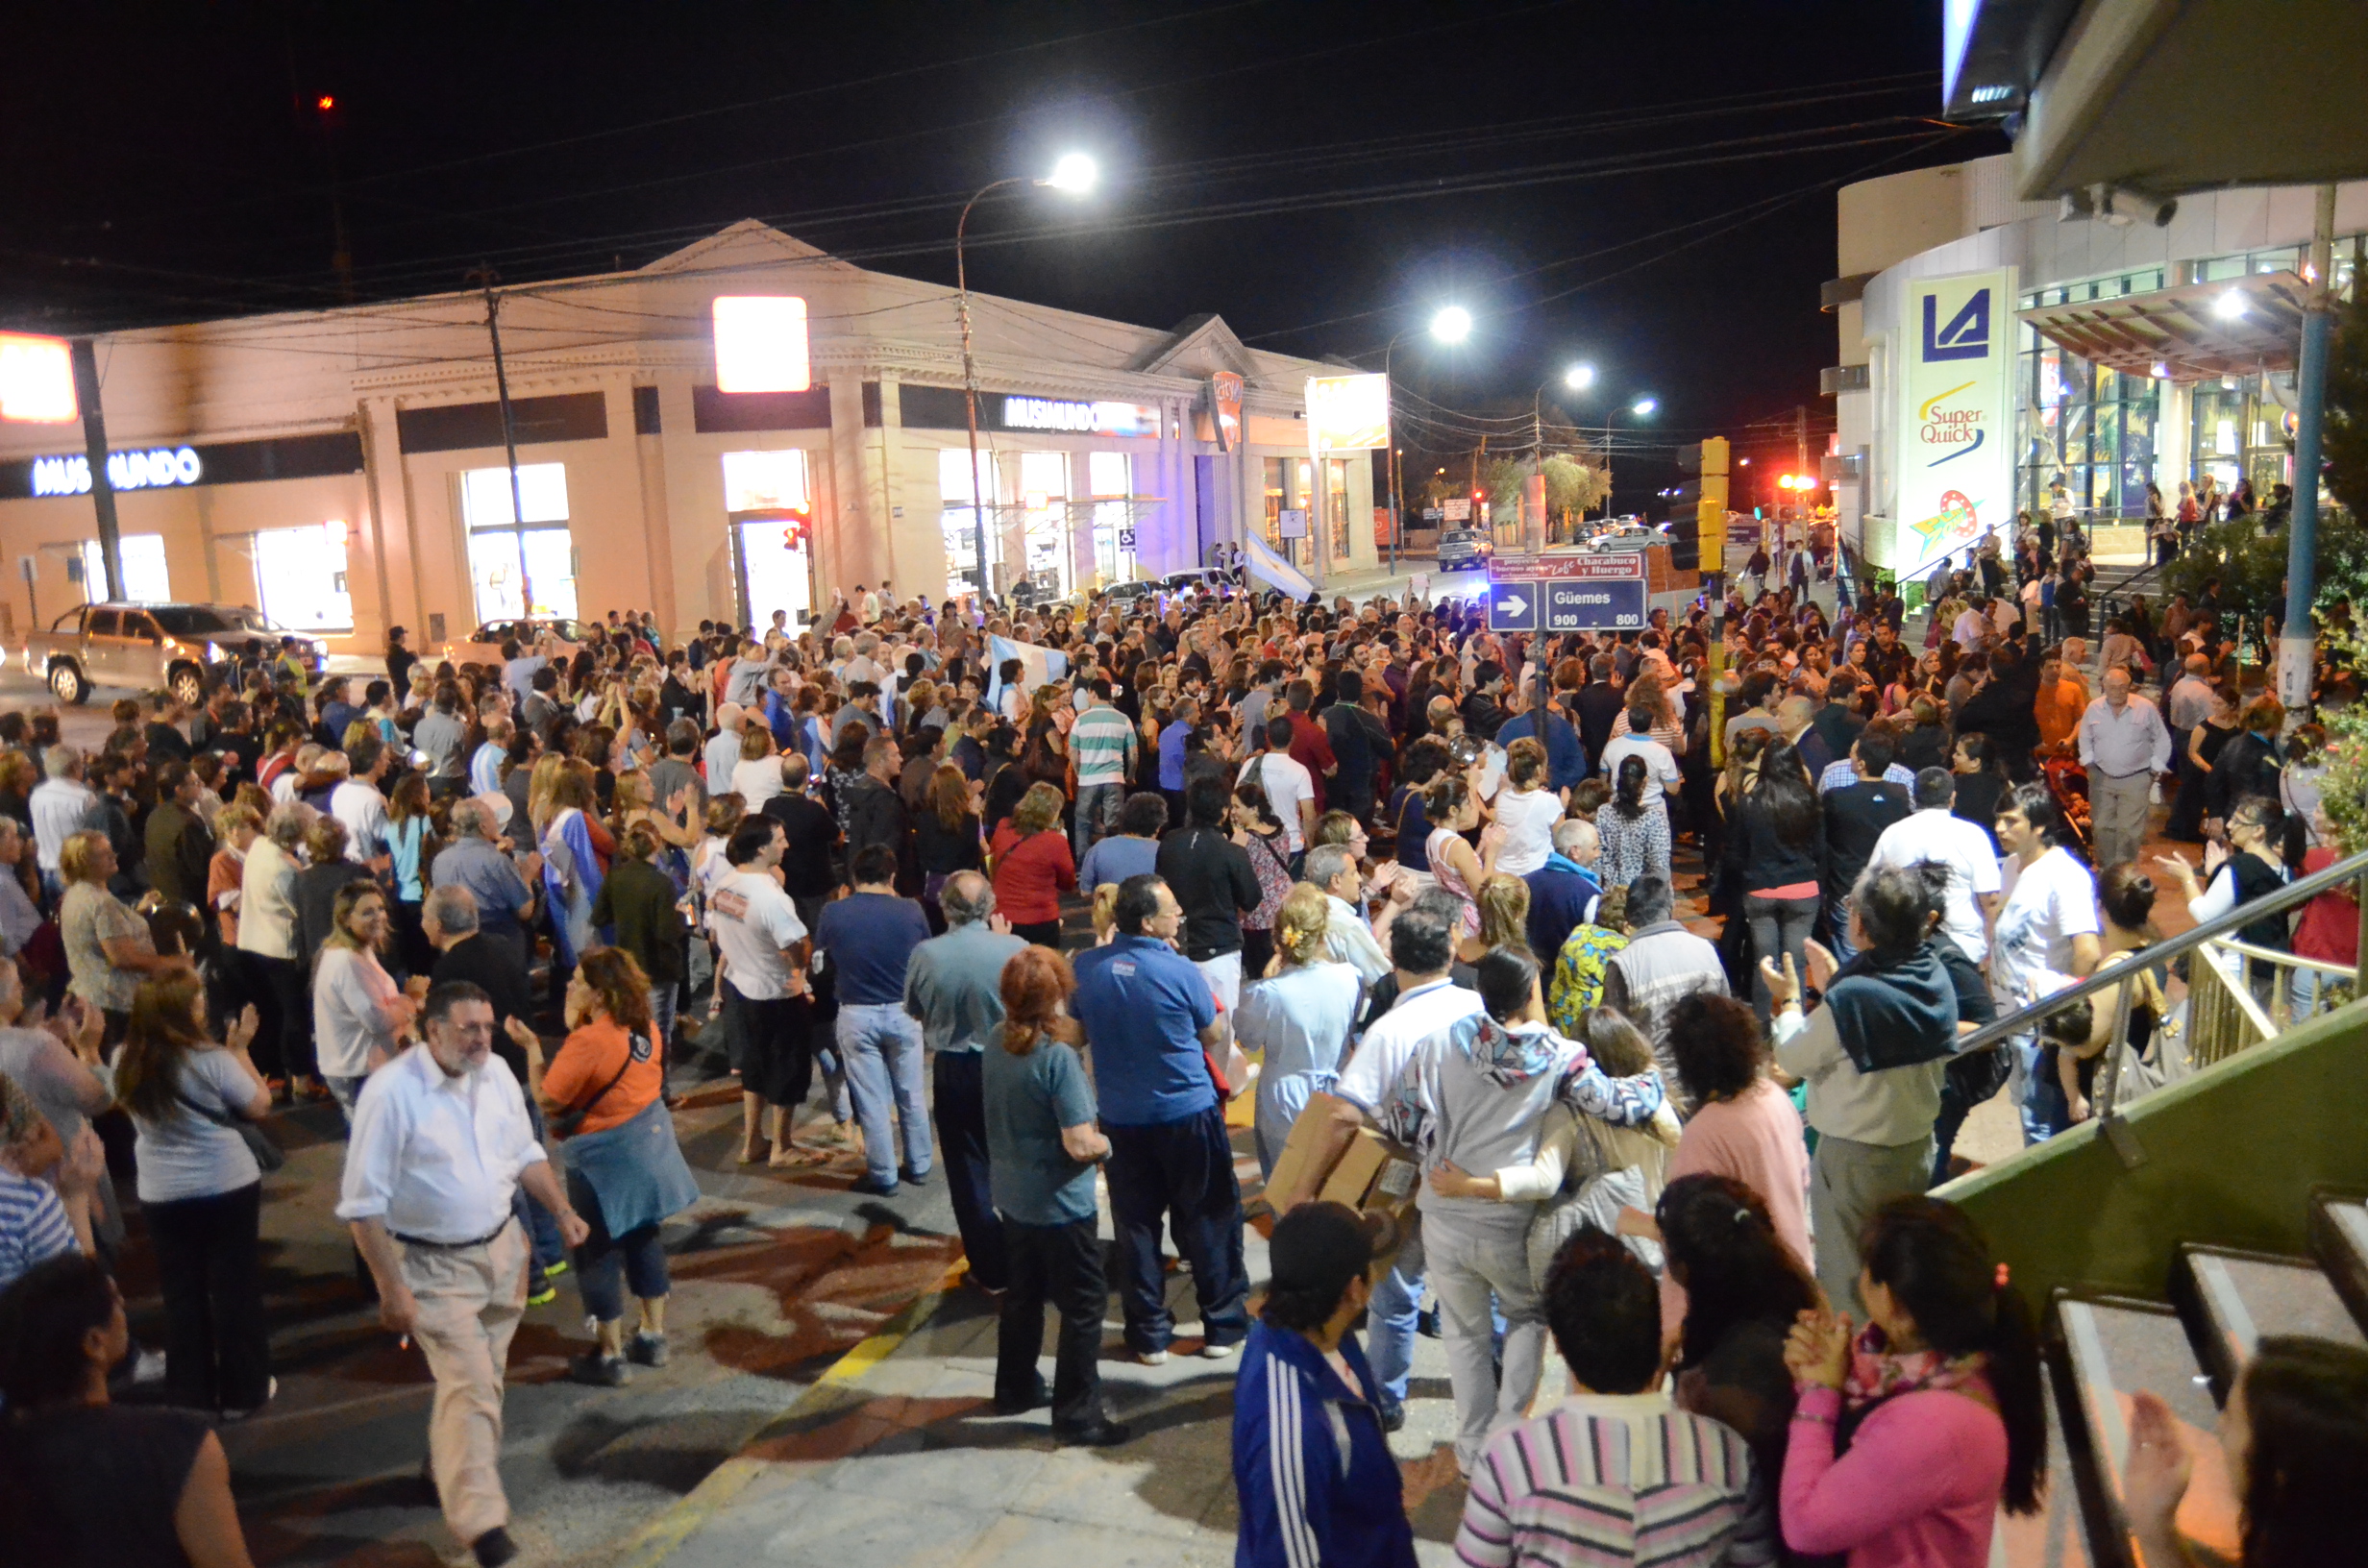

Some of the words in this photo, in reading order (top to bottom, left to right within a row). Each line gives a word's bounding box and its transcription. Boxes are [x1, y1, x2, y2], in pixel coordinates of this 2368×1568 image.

[1922, 287, 1990, 363] LA
[1005, 396, 1102, 431] MUSIMUNDO
[1930, 405, 1983, 429] Super
[1920, 422, 1975, 444] Quick
[1577, 556, 1636, 566] Chacabuco
[1591, 565, 1632, 575] Huergo
[1554, 591, 1611, 604] Güemes
[1553, 614, 1578, 625] 900
[1616, 613, 1639, 625] 800
